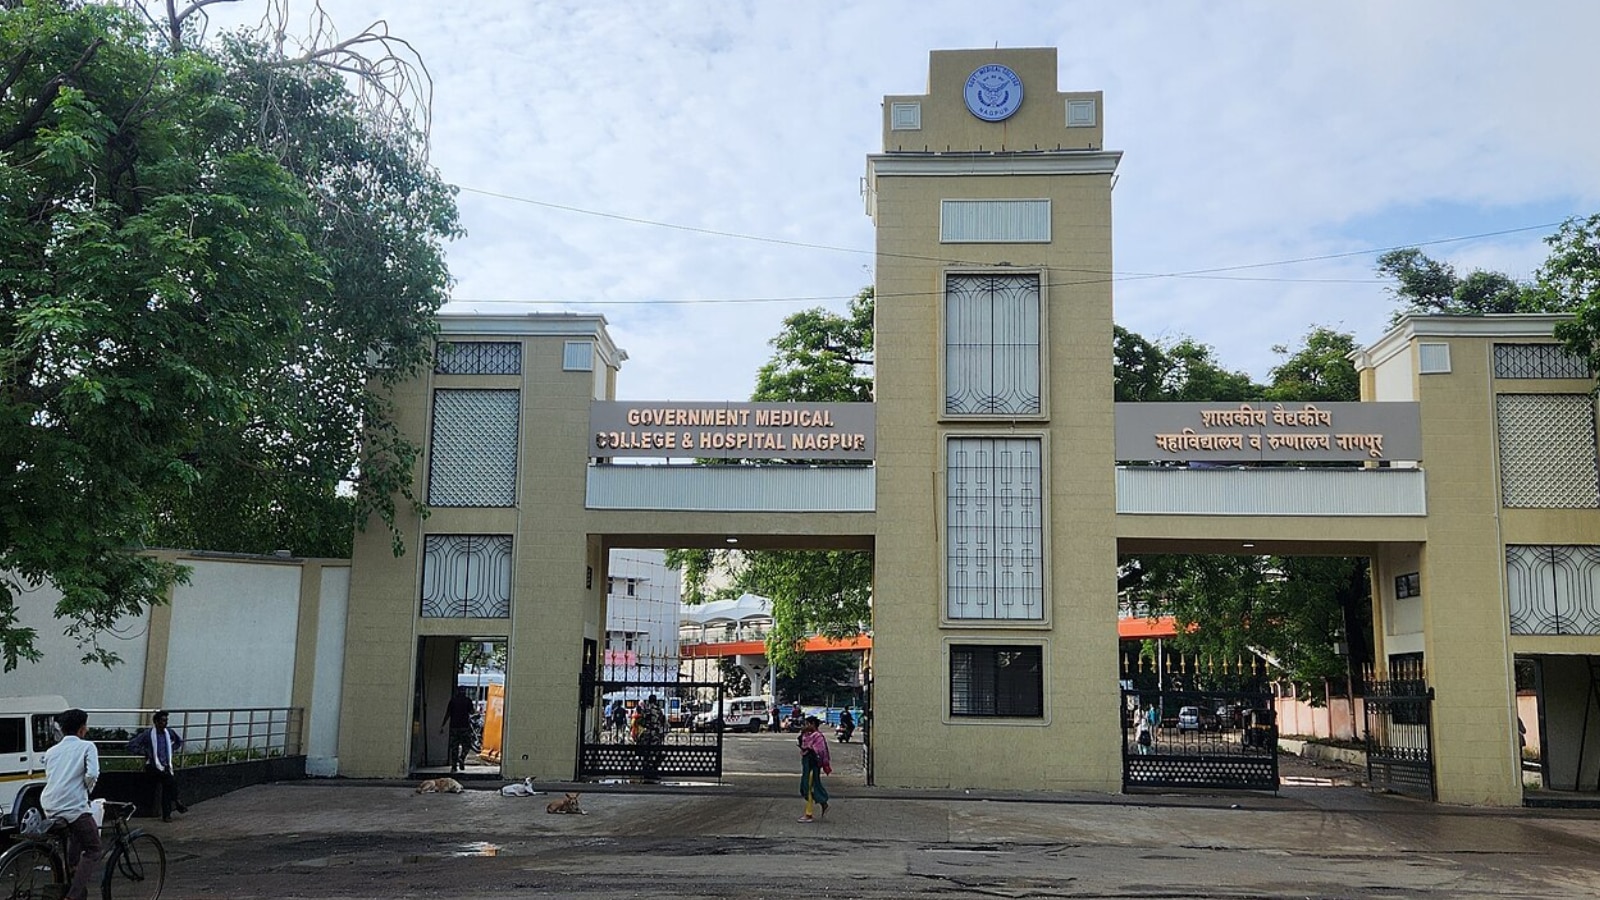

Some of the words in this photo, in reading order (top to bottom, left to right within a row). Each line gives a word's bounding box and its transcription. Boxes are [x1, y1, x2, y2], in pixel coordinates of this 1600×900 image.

[979, 107, 1009, 116] NAGPUR
[628, 409, 750, 427] GOVERNMENT
[755, 410, 834, 428] MEDICAL
[1201, 405, 1266, 427] शासकीय
[1272, 403, 1332, 427] वैद्यकीय
[596, 431, 676, 450] COLLEGE
[682, 432, 694, 449] &
[700, 432, 787, 450] HOSPITAL
[792, 433, 866, 451] NAGPUR
[1155, 428, 1243, 452] महाविद्यालय
[1250, 434, 1263, 451] व
[1266, 434, 1330, 451] रुग्णालय
[1335, 434, 1384, 457] नागपूर
